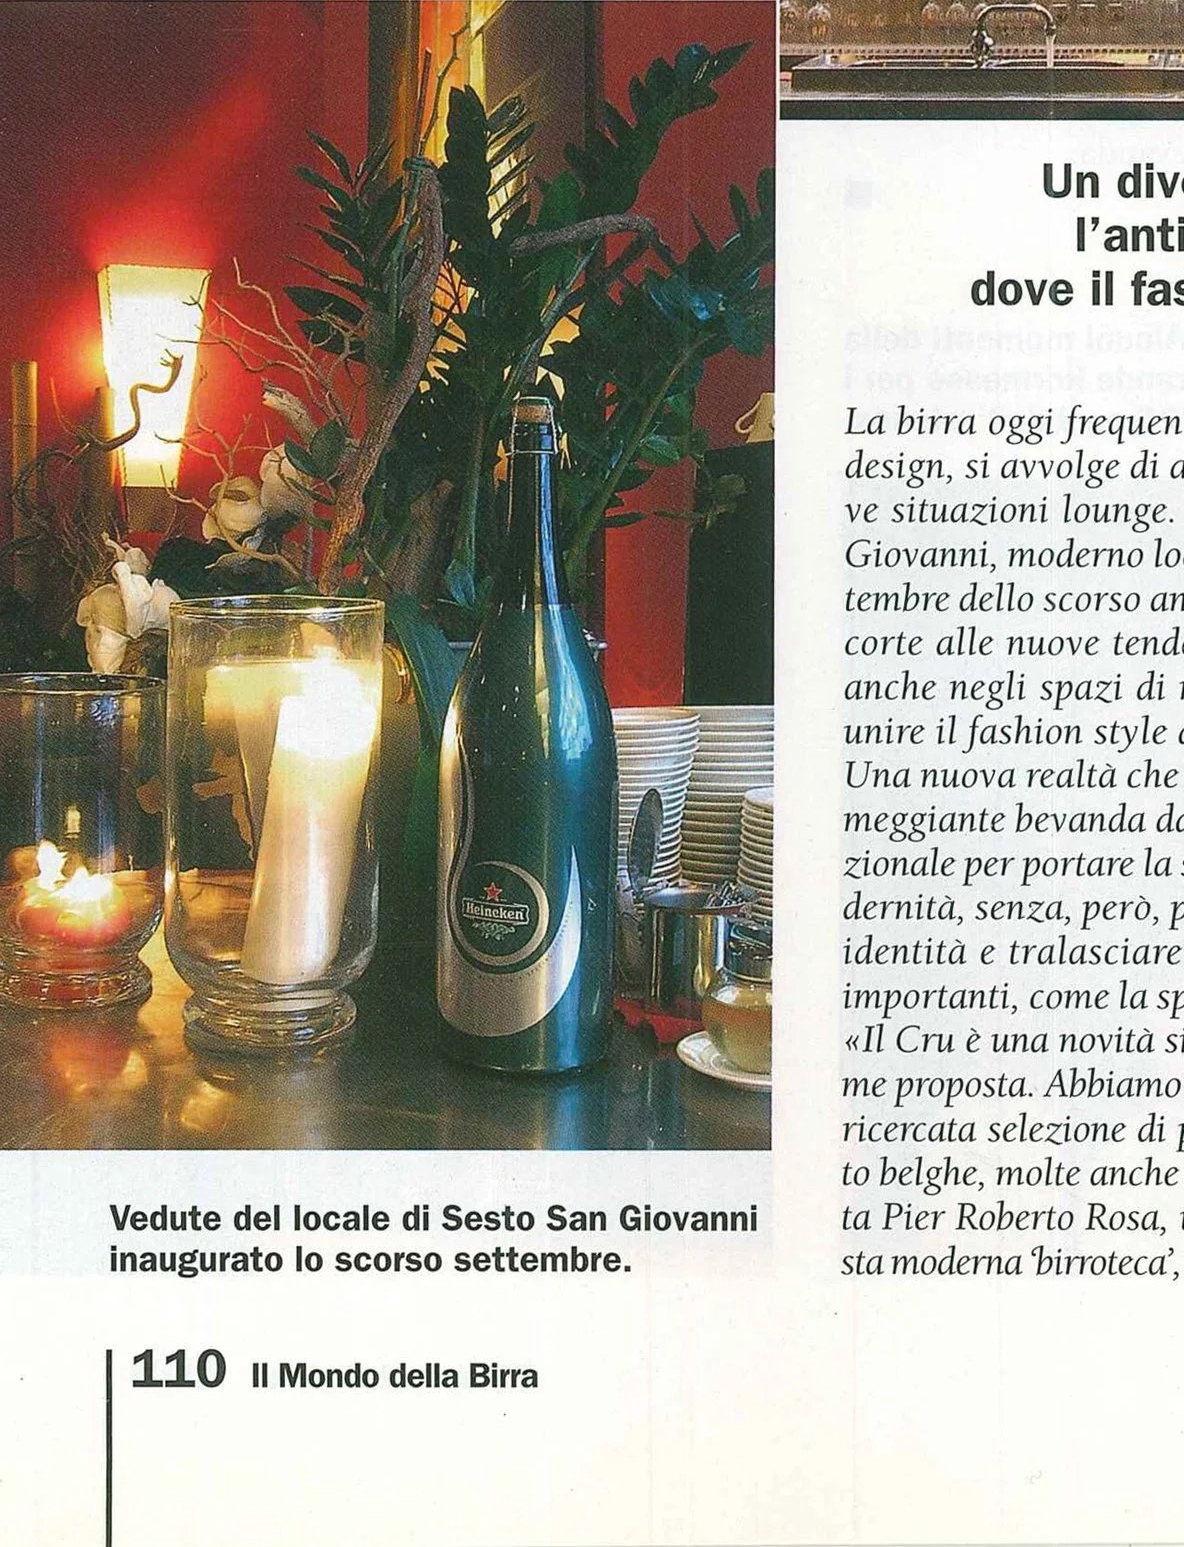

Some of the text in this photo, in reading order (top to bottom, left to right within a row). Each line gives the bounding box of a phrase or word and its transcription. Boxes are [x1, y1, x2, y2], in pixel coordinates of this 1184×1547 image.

[1043, 162, 1100, 199] Un
[970, 270, 1074, 307] dove
[1091, 269, 1114, 306] il
[844, 407, 886, 435] La
[897, 404, 977, 436] birra
[988, 408, 1054, 446] oggi
[845, 448, 953, 489] design,
[965, 452, 990, 479] si
[1000, 449, 1120, 489] avvolge
[1130, 449, 1159, 479] di
[844, 503, 879, 523] ve
[891, 496, 1048, 526] situazioni
[1063, 493, 1174, 534] lounge.
[844, 631, 923, 656] corte
[936, 625, 994, 656] alle
[1006, 636, 1100, 656] nuove
[845, 760, 911, 789] Una
[920, 768, 1016, 789] nuova
[1026, 758, 1117, 789] realtà
[1127, 758, 1179, 789] che
[466, 902, 525, 921] Heineken
[843, 890, 964, 926] dernità,
[974, 900, 1071, 926] senza,
[1080, 895, 1159, 931] però,
[843, 1115, 977, 1143] ricercata
[987, 1112, 1127, 1146] selezione
[1137, 1112, 1166, 1143] di
[109, 1204, 757, 1232] Vedute del locale di Sesto San Giovanni
[110, 1245, 631, 1279] inaugurato lo scorso settembre.
[132, 1348, 538, 1389] 110 Il Mondo della Birra
